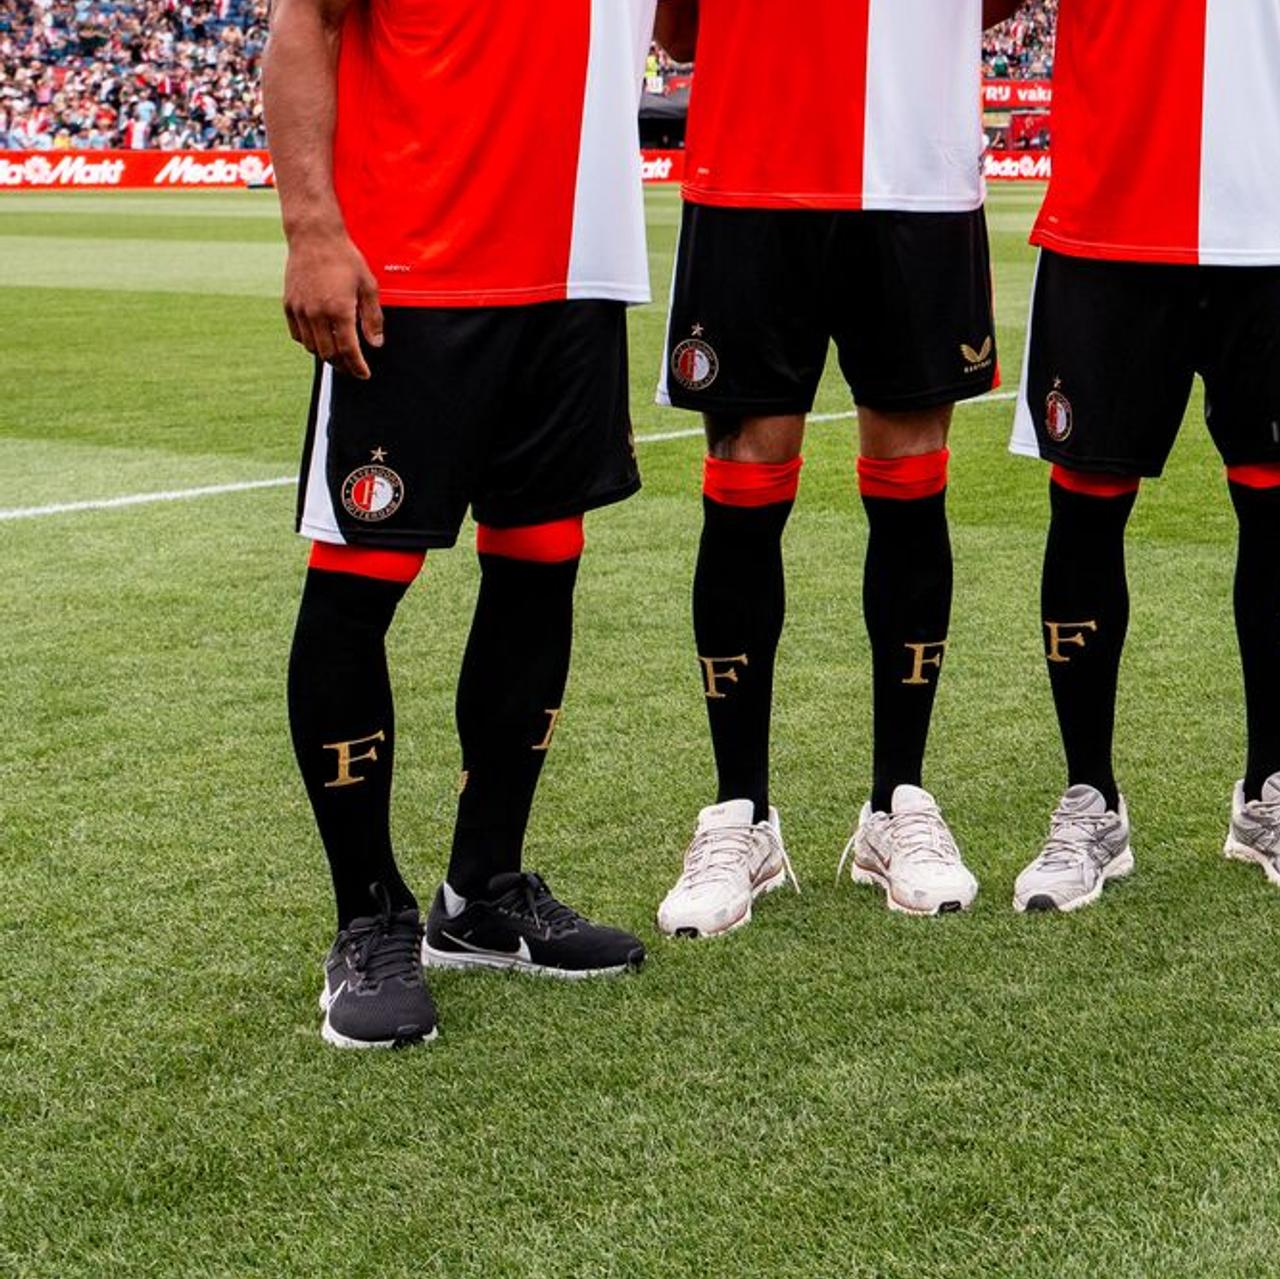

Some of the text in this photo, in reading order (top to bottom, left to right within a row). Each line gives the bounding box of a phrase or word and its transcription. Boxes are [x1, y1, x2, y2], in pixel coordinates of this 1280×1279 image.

[51, 156, 125, 185] Markt
[153, 156, 241, 184] Media
[902, 640, 950, 685] F
[1044, 620, 1097, 663] F
[701, 653, 749, 699] F
[322, 730, 385, 788] F
